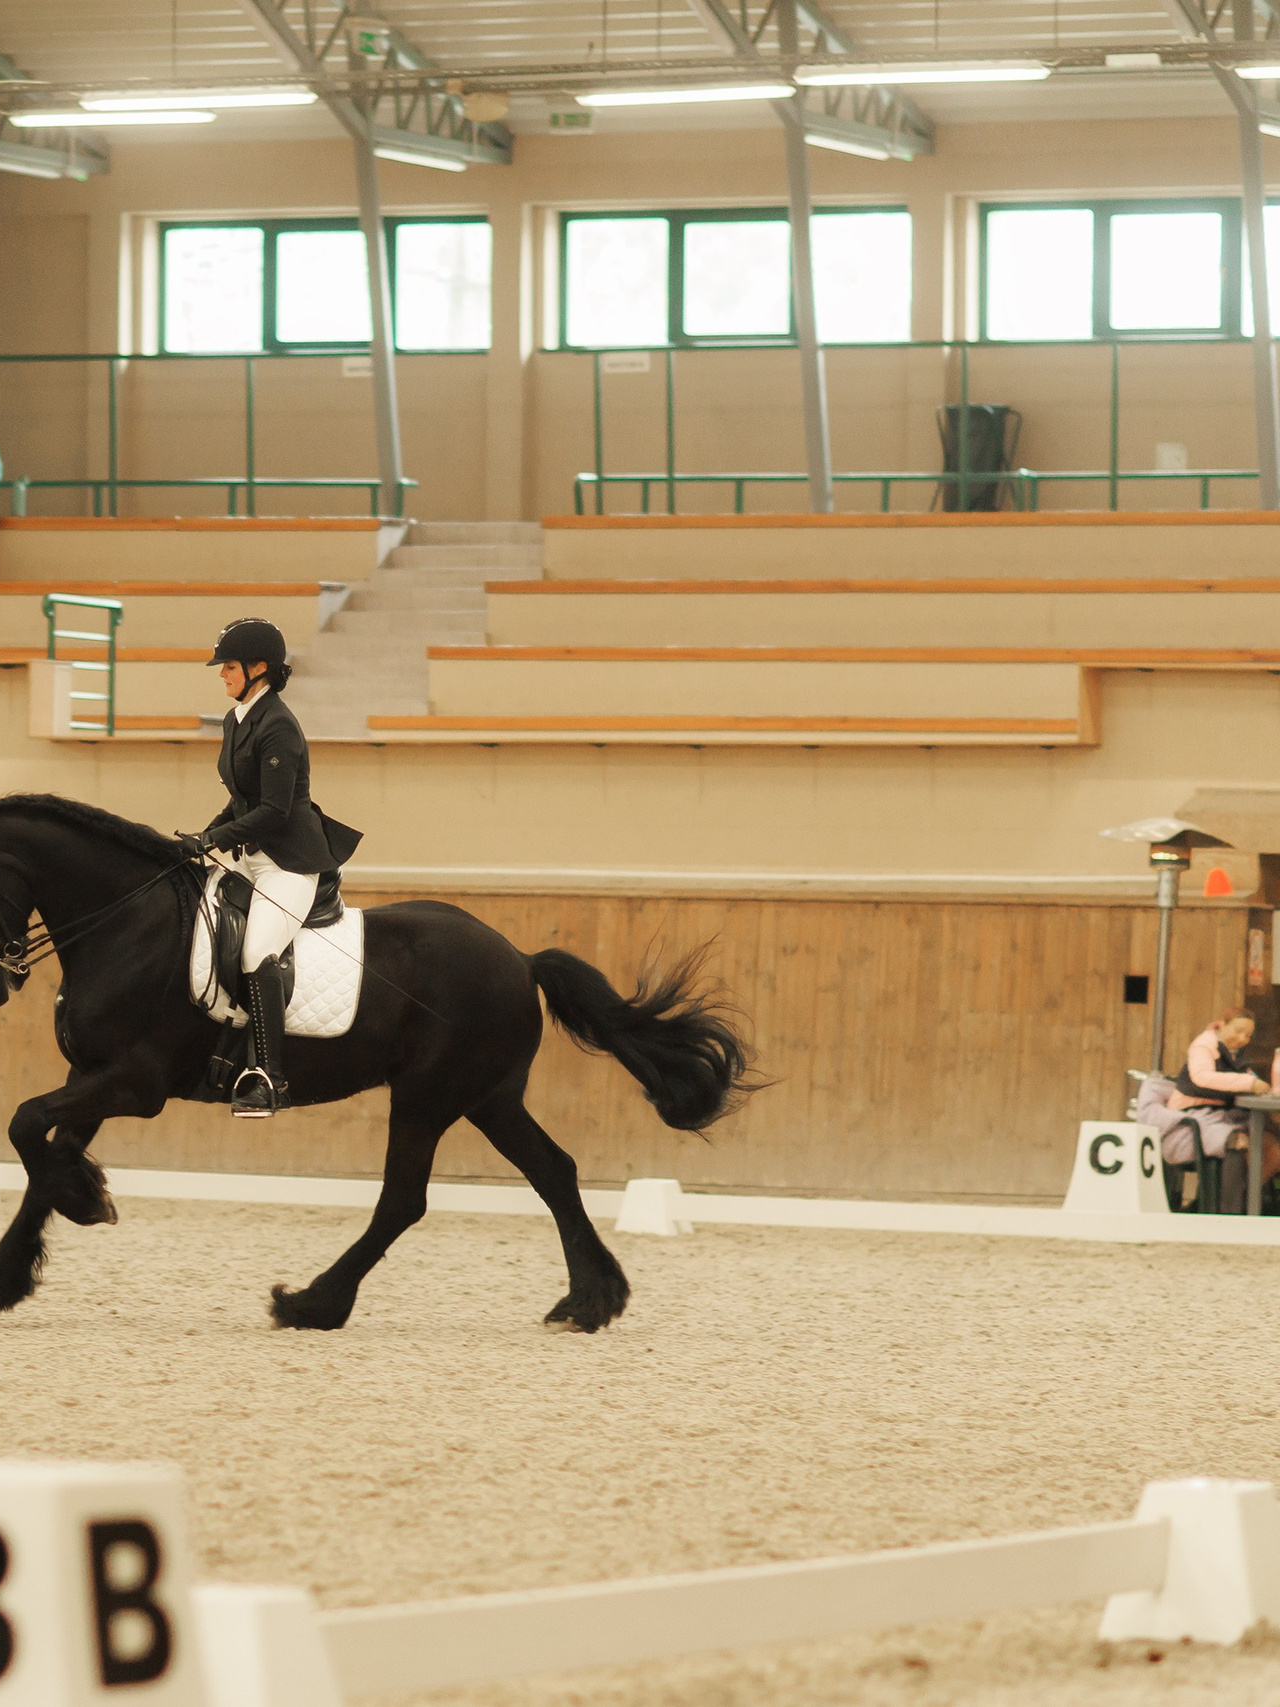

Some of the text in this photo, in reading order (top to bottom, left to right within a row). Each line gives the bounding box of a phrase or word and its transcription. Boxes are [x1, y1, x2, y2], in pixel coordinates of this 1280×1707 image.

[1089, 1133, 1125, 1176] C
[1140, 1136, 1155, 1179] C
[85, 1517, 174, 1688] B
